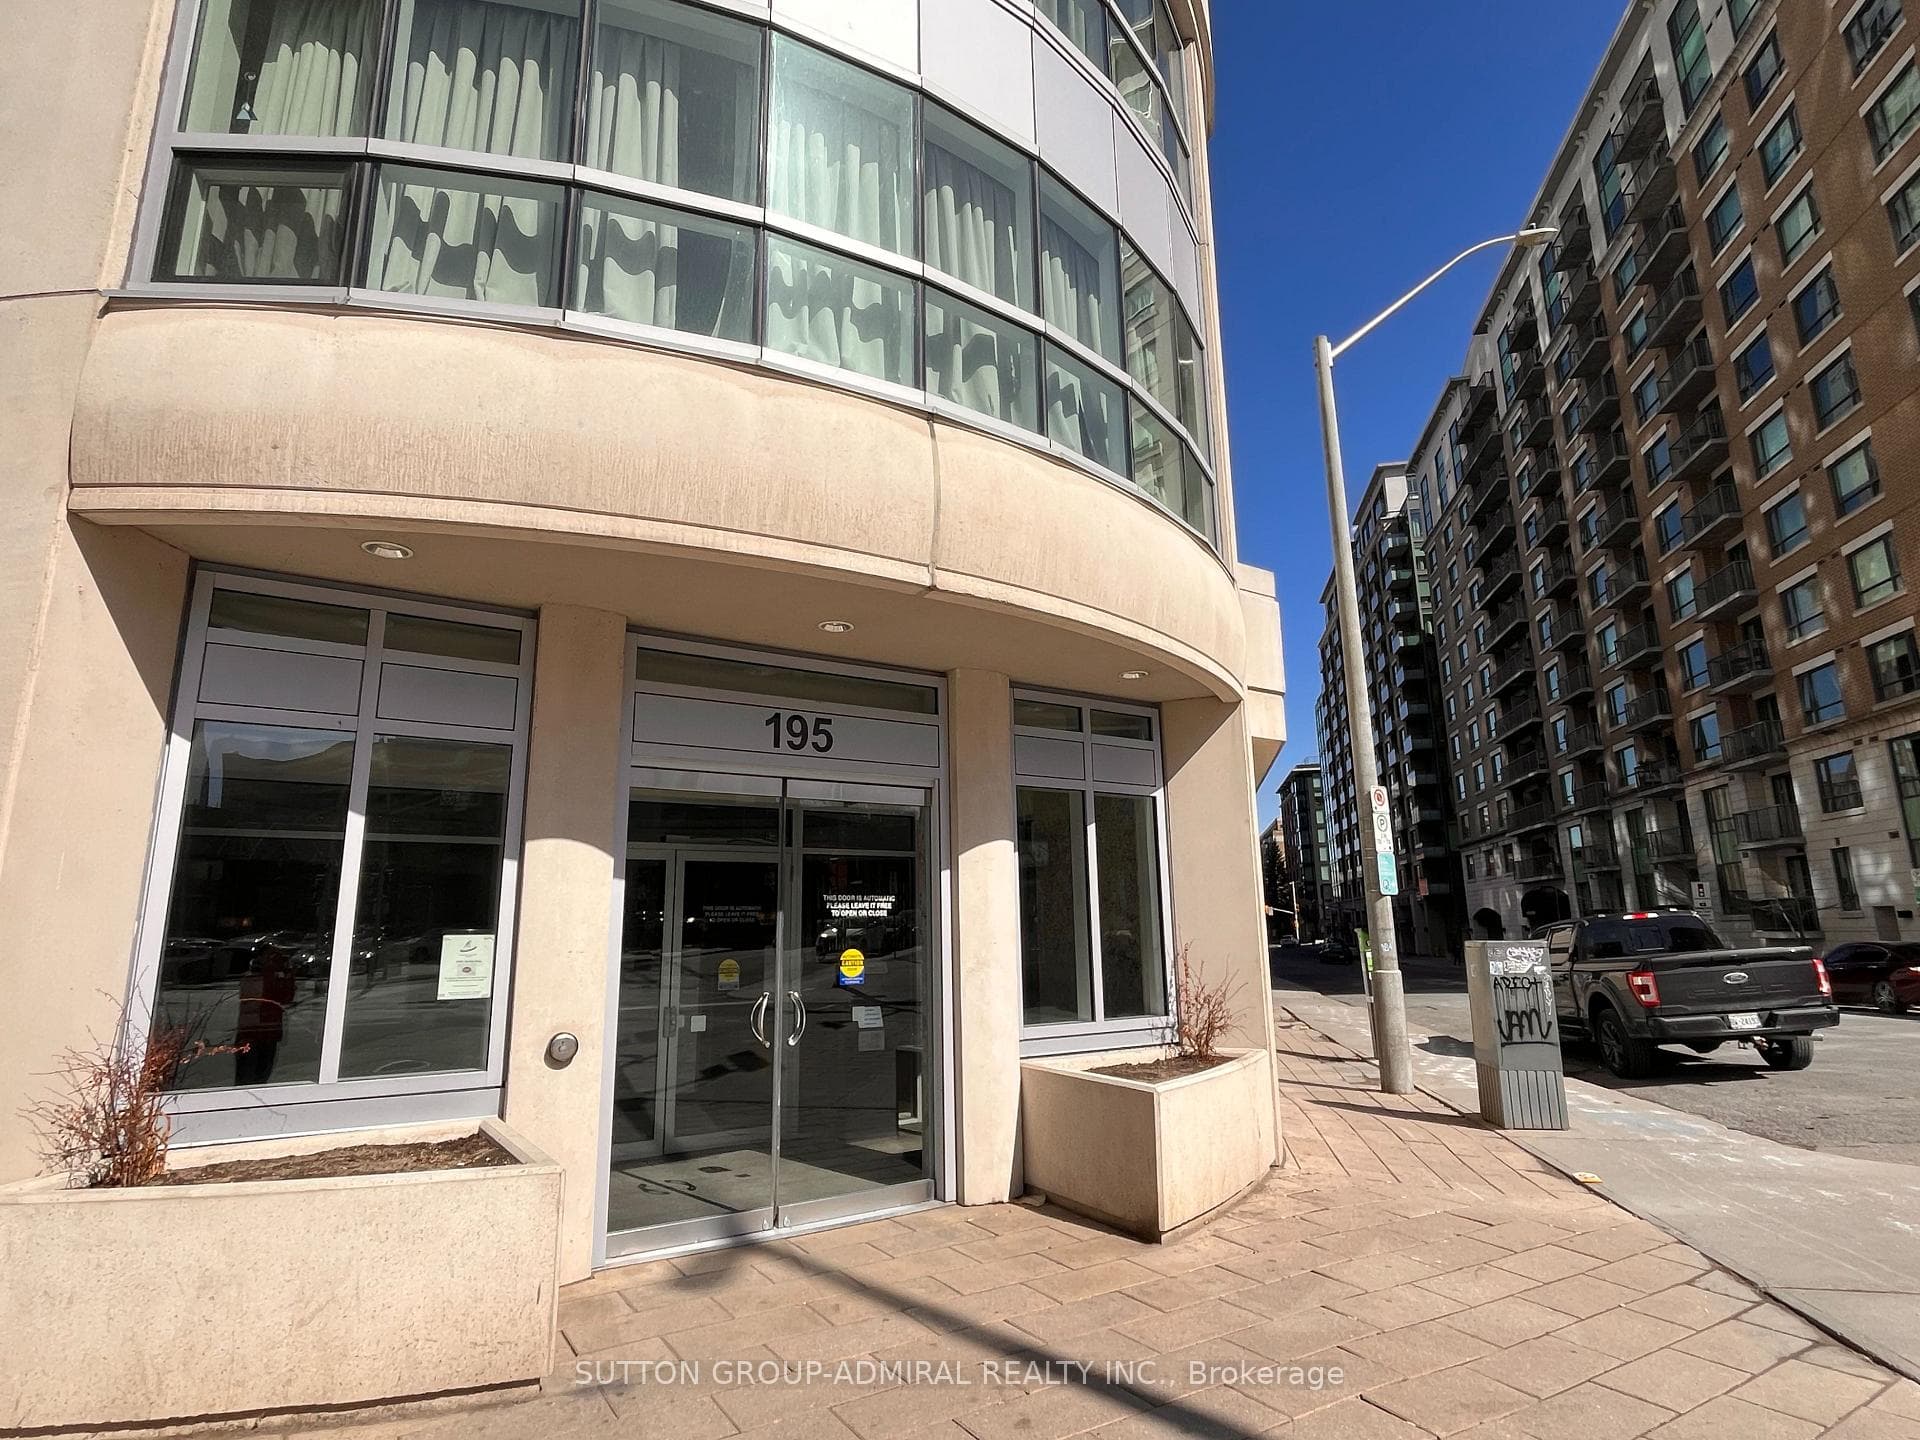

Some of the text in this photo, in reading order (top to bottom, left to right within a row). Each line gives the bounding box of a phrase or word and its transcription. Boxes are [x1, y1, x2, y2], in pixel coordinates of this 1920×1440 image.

[765, 712, 834, 753] 195
[831, 909, 888, 917] TO OPEN OR CLOSE
